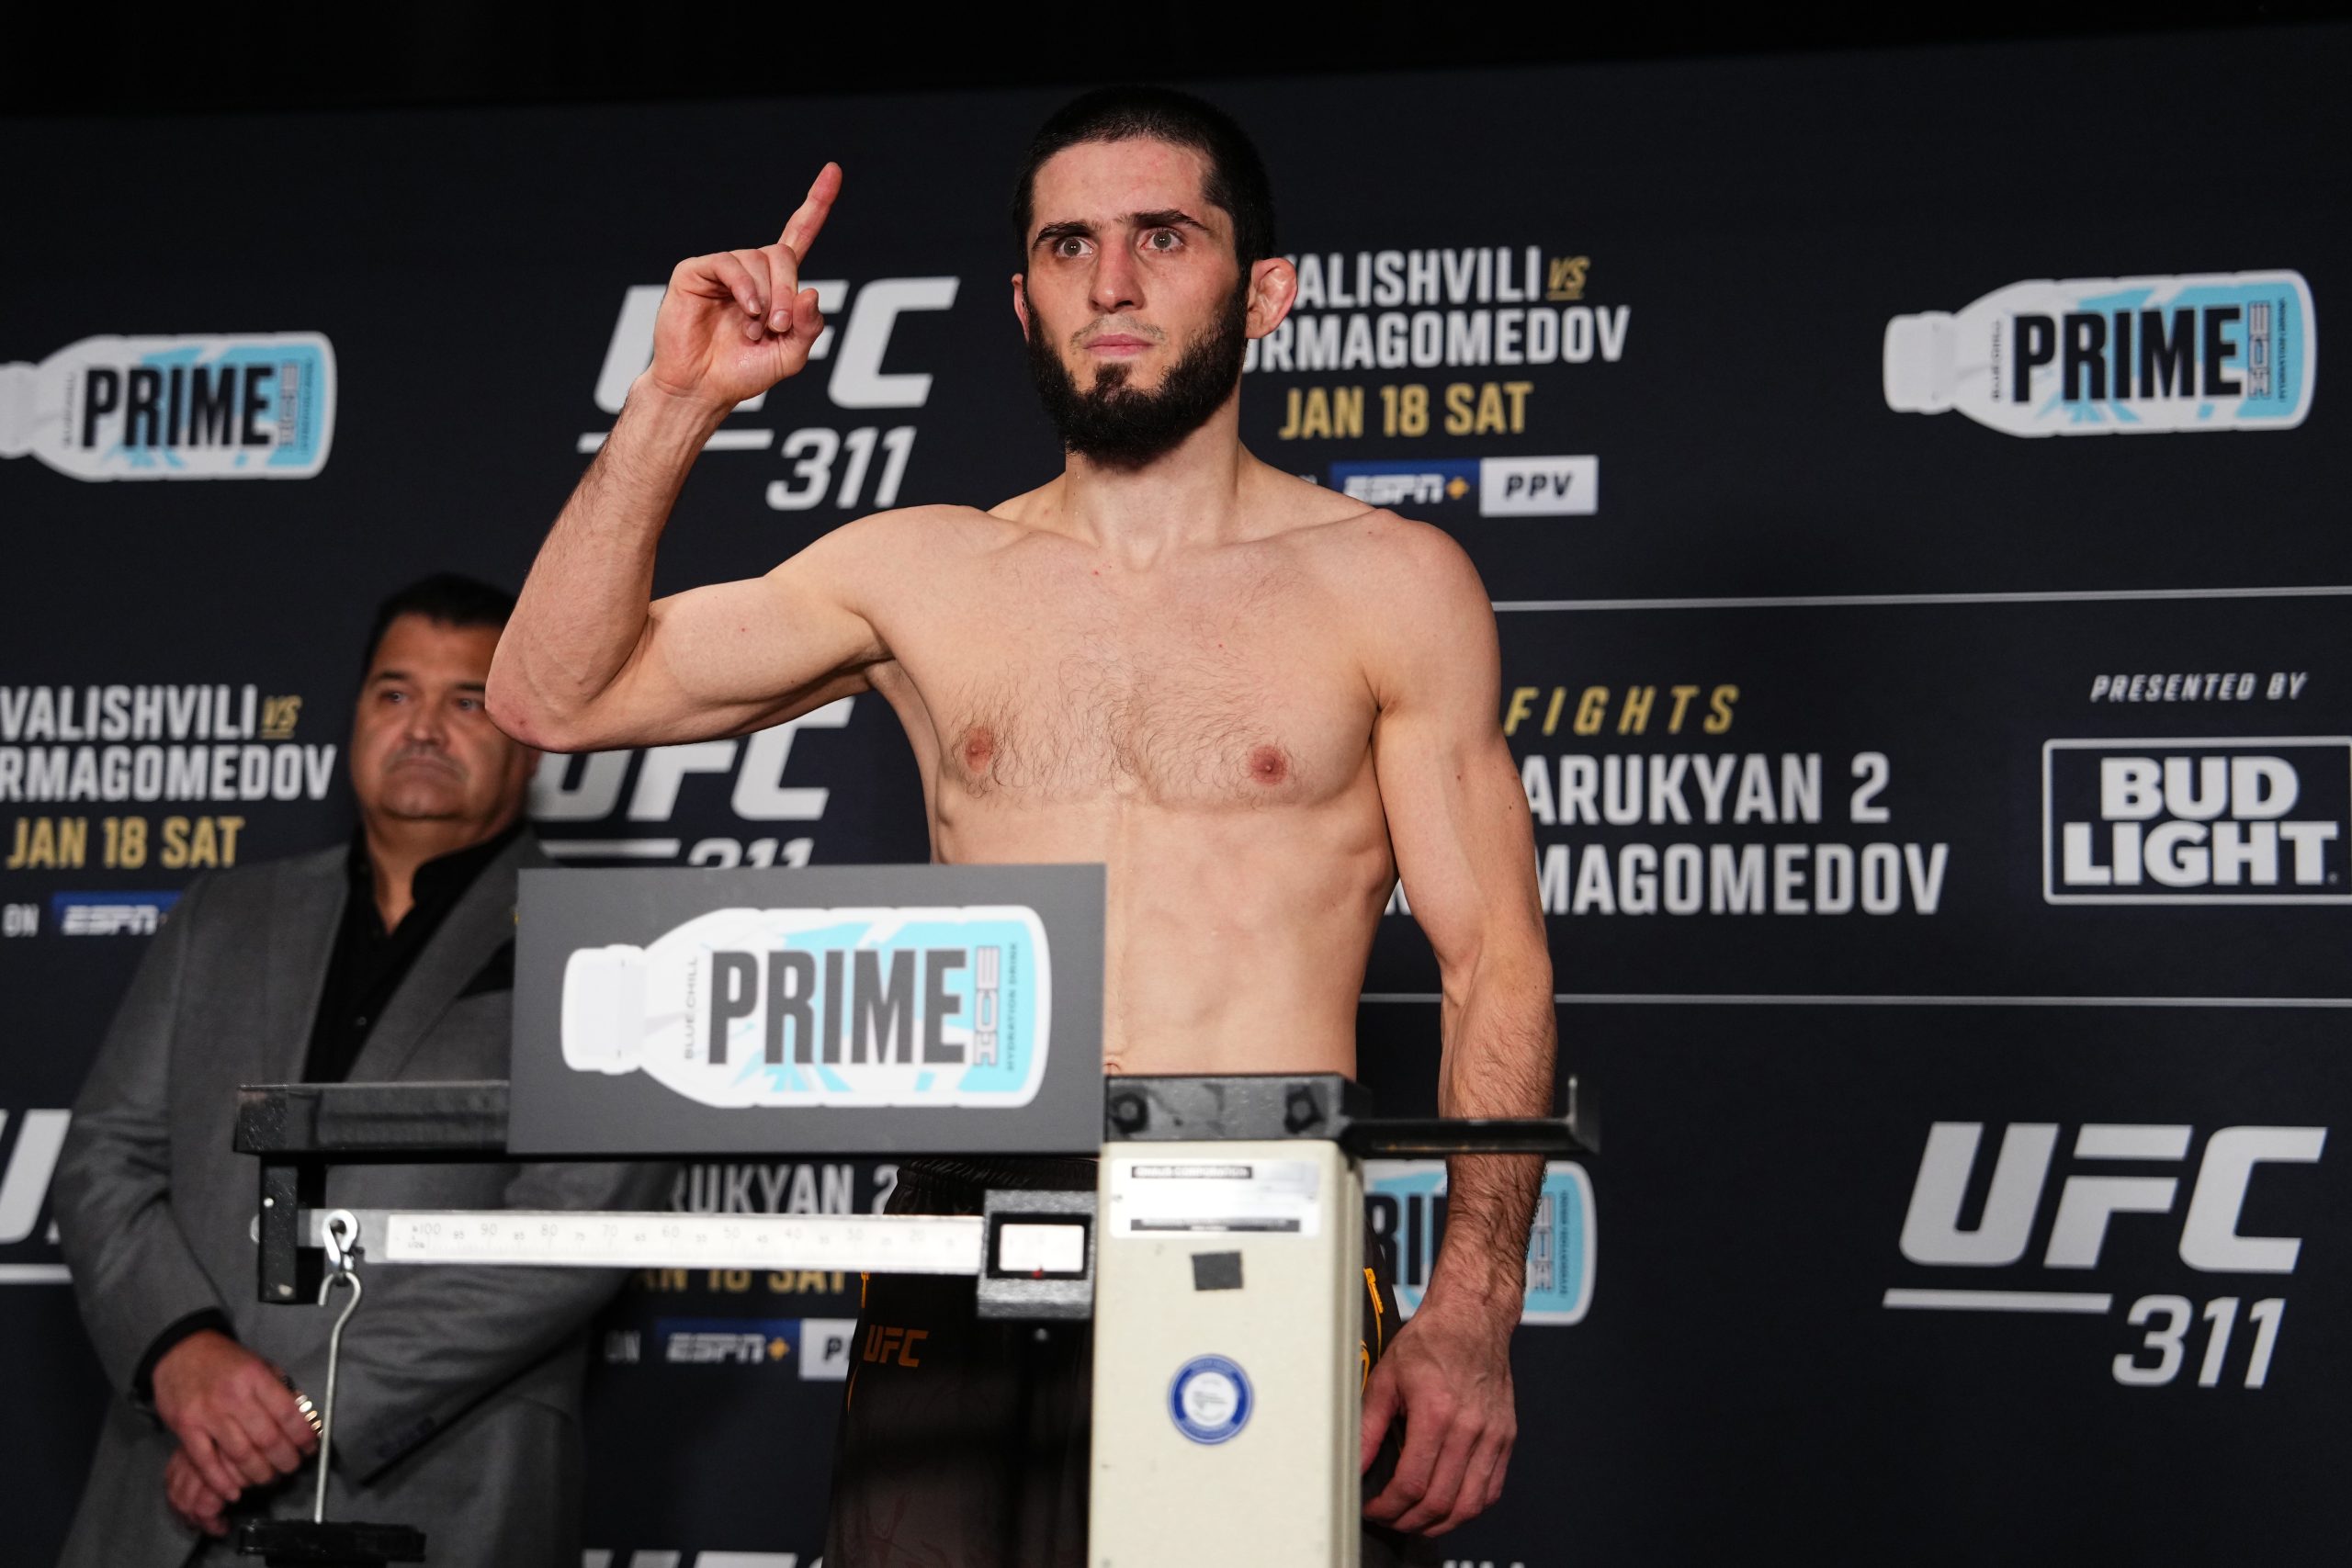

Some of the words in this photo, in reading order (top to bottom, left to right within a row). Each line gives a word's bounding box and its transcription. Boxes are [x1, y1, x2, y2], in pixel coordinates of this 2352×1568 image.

[1283, 246, 1542, 310] ALISHVILI
[1547, 256, 1590, 300] VS
[2013, 305, 2242, 405] PRIME
[83, 367, 275, 448] PRIME
[1279, 387, 1364, 440] JAN
[1381, 384, 1429, 436] 18
[1445, 381, 1533, 436] SAT
[765, 425, 916, 511] 311
[1503, 473, 1574, 500] PPV
[0, 684, 257, 741] VALISHVILI
[261, 695, 302, 739] VS
[1505, 684, 1740, 736] FIGHTS
[2090, 673, 2256, 702] PRESENTED
[2267, 671, 2307, 700] BY
[0, 745, 336, 802] RMAGOMEDOV
[1521, 753, 1822, 825] ARUKYAN
[1849, 751, 1890, 823] 2
[2100, 756, 2299, 821] BUD
[7, 817, 87, 870] JAN
[104, 817, 148, 869] 18
[161, 816, 244, 869] SAT
[2064, 820, 2338, 886] LIGHT
[3, 904, 40, 936] ON
[62, 905, 160, 935] ESPN
[685, 956, 697, 1009] CHILL
[708, 949, 967, 1065] PRIME
[684, 1013, 695, 1060] BLUE
[1899, 1122, 2327, 1274] UFC
[864, 1325, 929, 1367] UFC
[2112, 1294, 2287, 1389] 311
